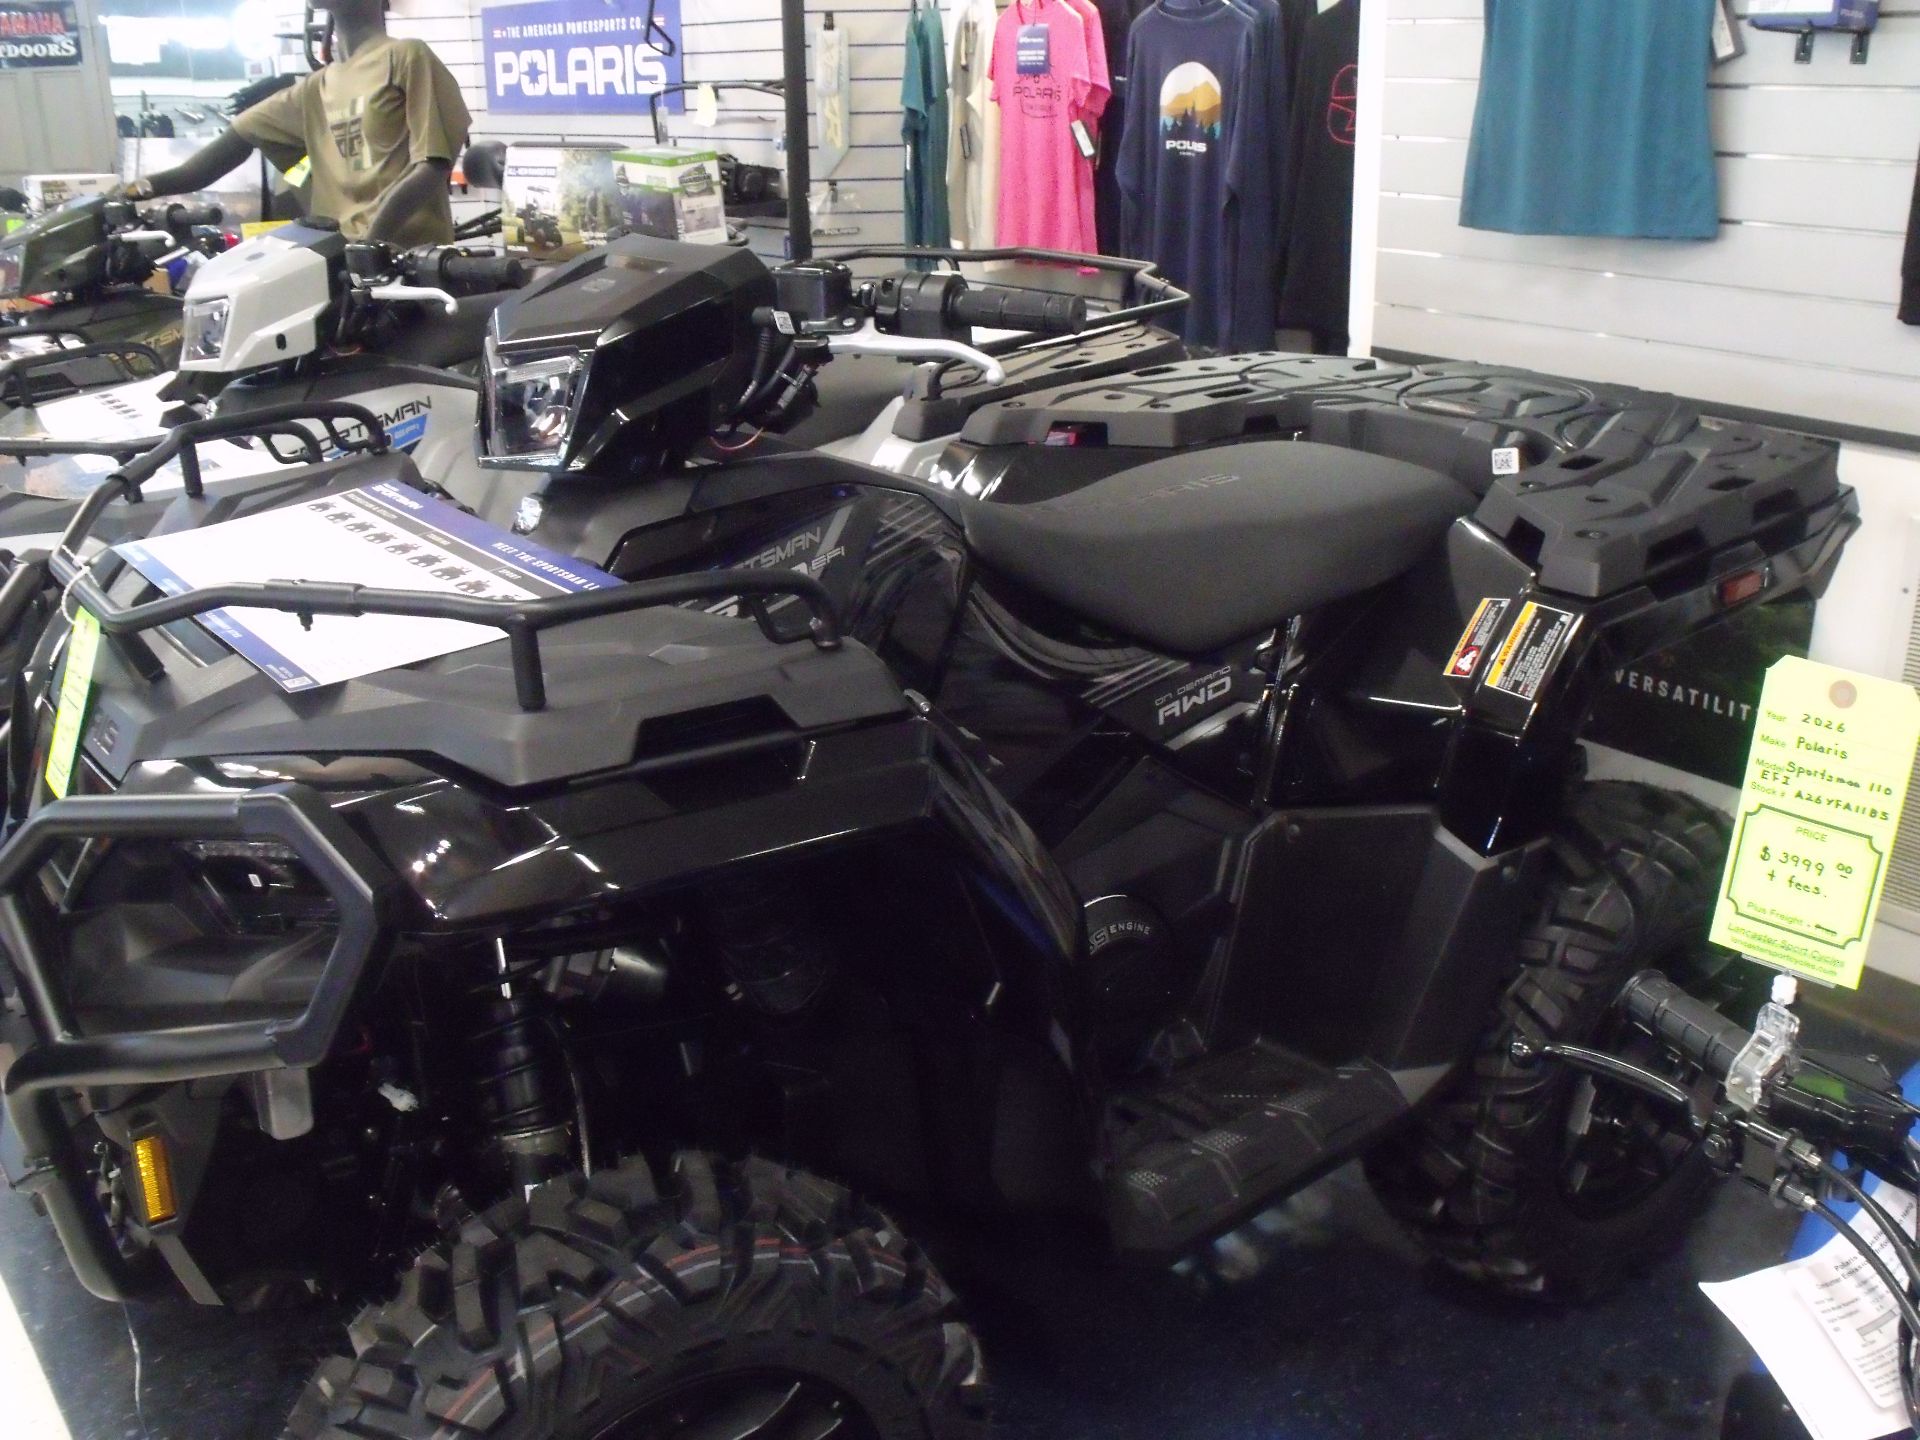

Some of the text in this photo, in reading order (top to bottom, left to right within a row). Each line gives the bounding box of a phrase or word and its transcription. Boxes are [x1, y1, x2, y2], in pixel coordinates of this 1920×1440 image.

[506, 16, 645, 38] THE AMERICAN POWERSPORTS CO.
[494, 43, 667, 97] POLARIS
[491, 541, 518, 557] MEET
[514, 549, 535, 563] THE
[531, 558, 588, 585] SPORTSMAN
[811, 546, 845, 571] EFI
[1155, 665, 1231, 706] ON DEMAND
[1615, 669, 1759, 721] VERSATILIT
[1158, 676, 1232, 726] AWD
[1766, 710, 1846, 733] Year 2026
[1760, 734, 1848, 759] Make Polaris
[1751, 781, 1776, 796] Stock
[1760, 769, 1790, 785] EFI
[1868, 782, 1893, 796] 110
[1795, 826, 1829, 843] PRICE
[1778, 852, 1825, 877] 3999
[1747, 902, 1804, 925] Plus Freight
[1109, 921, 1151, 935] ENGINE
[1727, 923, 1778, 945] Lancaster
